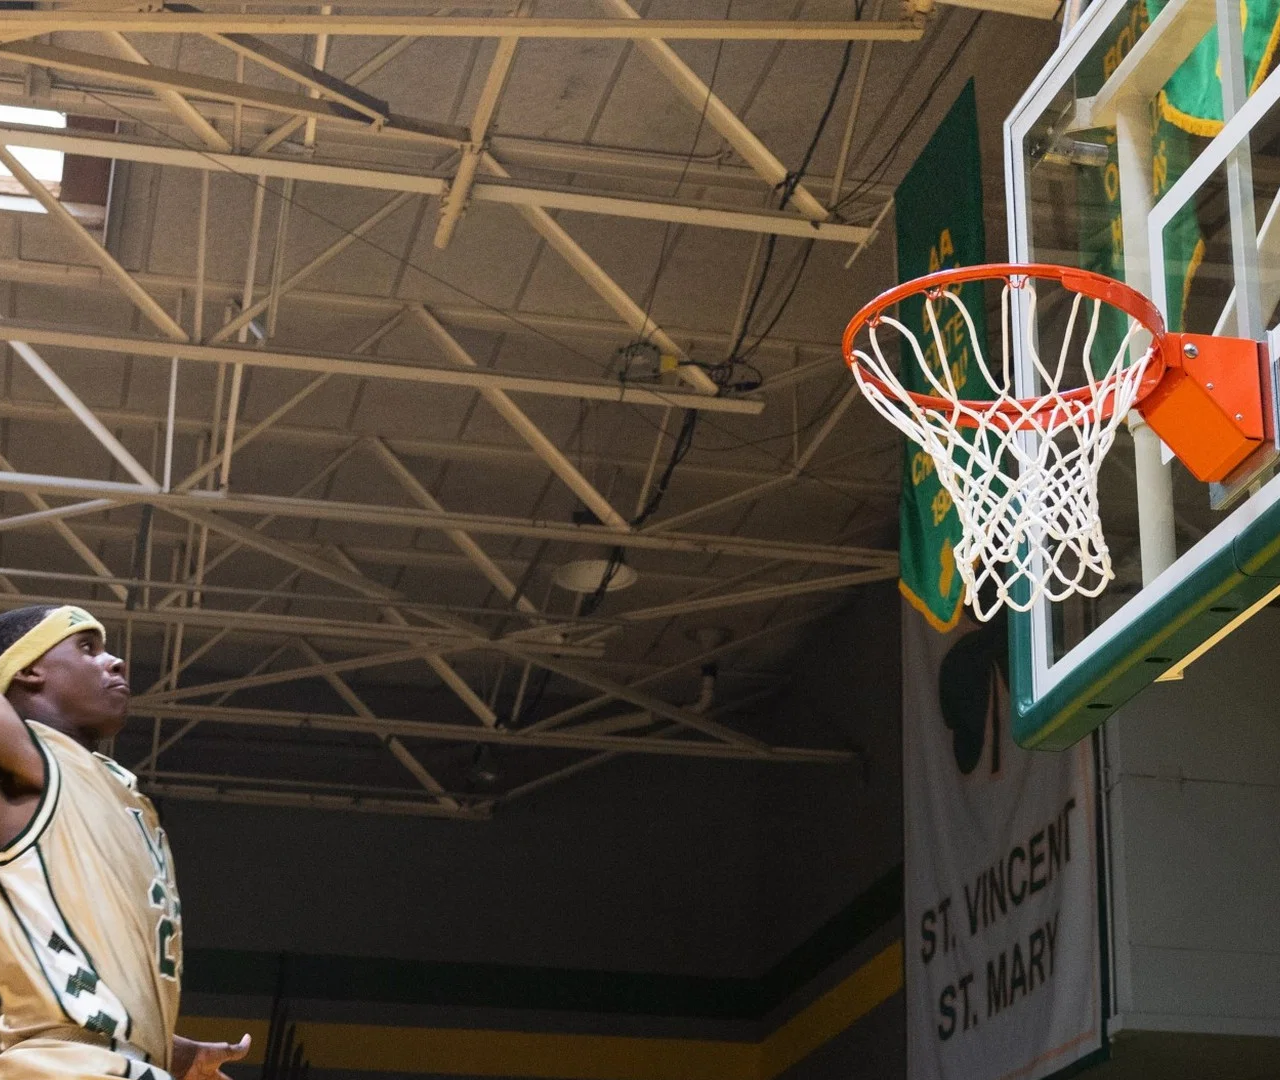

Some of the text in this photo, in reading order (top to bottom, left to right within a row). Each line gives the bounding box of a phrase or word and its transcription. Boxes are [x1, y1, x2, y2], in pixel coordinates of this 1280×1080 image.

[920, 798, 1076, 965] ST. VINCENT
[937, 908, 1060, 1041] ST. MARY
